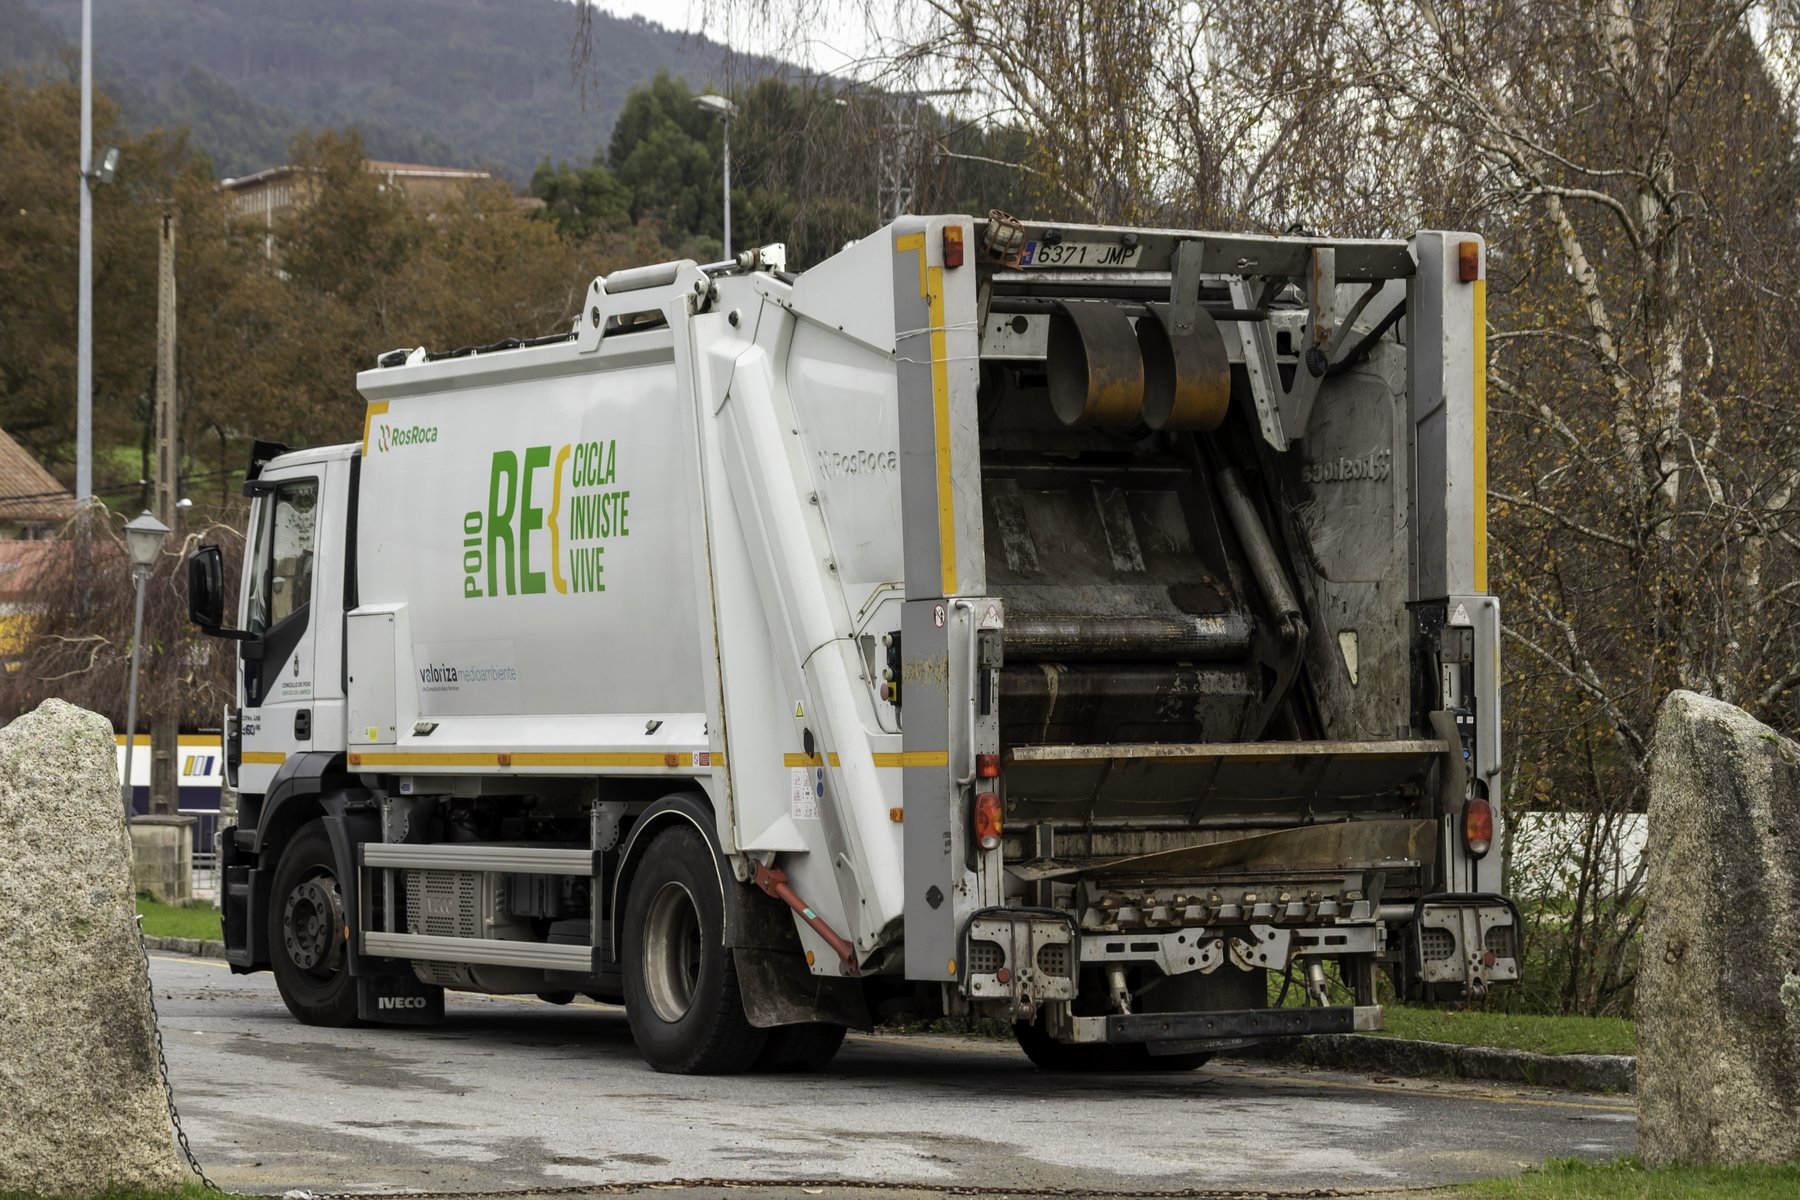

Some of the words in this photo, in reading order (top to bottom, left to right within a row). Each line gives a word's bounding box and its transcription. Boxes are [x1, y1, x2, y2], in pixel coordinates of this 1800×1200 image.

[1038, 246, 1088, 264] 6371
[1097, 247, 1135, 265] JMP
[391, 425, 438, 446] RosRoca
[572, 439, 616, 488] CICLA
[570, 490, 630, 541] INVISTE
[463, 511, 483, 599] POIO
[569, 546, 606, 593] VIVE
[420, 663, 458, 683] valoriza
[378, 997, 426, 1009] IVECO
